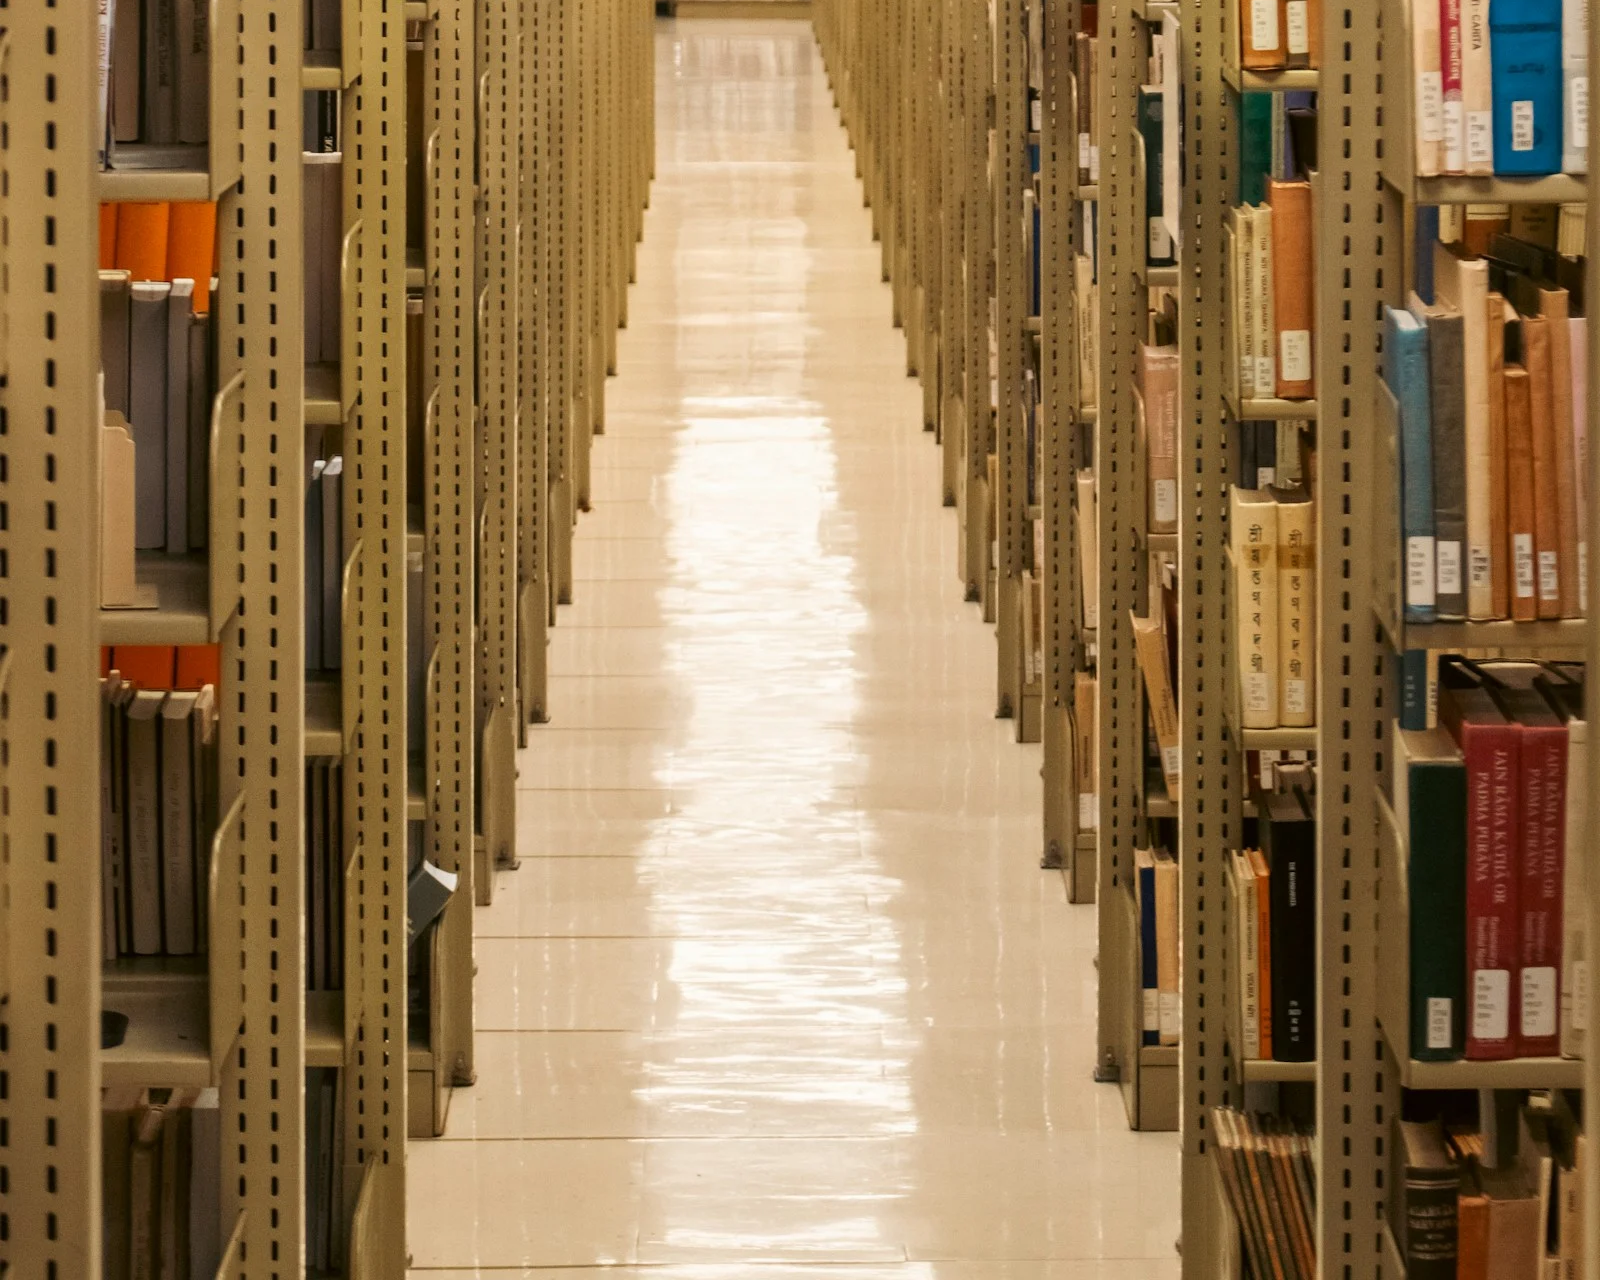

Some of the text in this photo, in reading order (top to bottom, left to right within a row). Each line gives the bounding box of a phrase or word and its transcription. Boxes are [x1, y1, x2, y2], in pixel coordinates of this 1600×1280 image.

[1494, 749, 1509, 780] JAIN
[1547, 745, 1560, 776] JAIN
[1475, 772, 1490, 821] PADMA
[1493, 883, 1506, 904] OR
